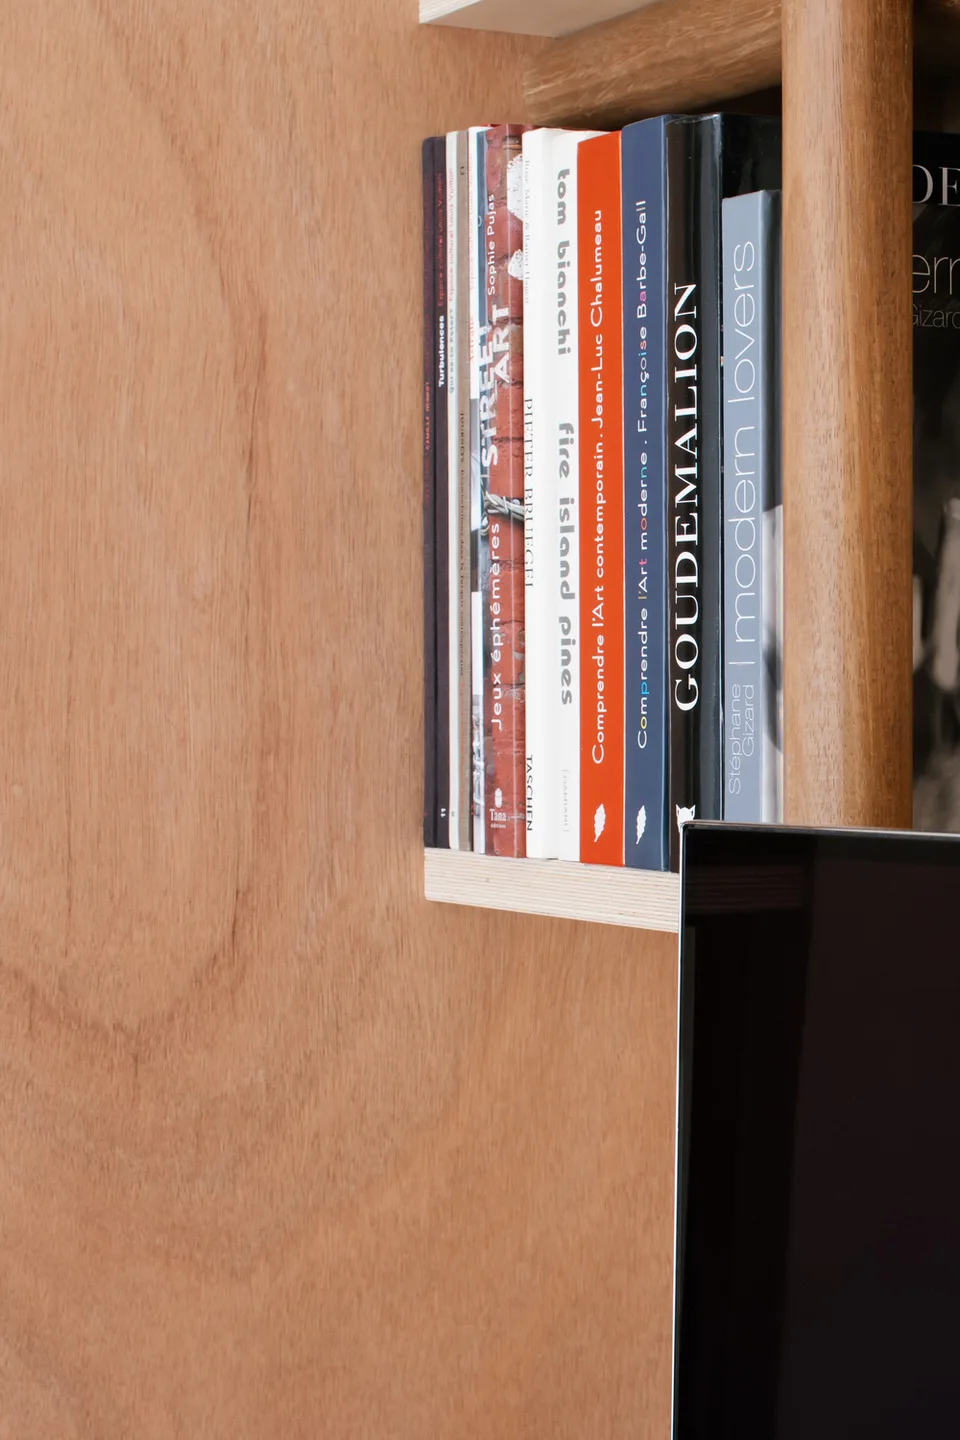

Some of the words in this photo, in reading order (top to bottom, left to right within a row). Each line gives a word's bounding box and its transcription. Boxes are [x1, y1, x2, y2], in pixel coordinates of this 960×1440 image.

[486, 193, 496, 229] Pujas
[556, 167, 571, 226] tom
[486, 241, 497, 297] Sophie
[556, 239, 571, 357] bianchi
[590, 208, 604, 329] Chalumeau
[635, 199, 648, 320] Barbe-Gall
[438, 314, 446, 388] Turbulences
[491, 303, 510, 385] ART
[727, 240, 757, 404] lovers
[479, 323, 498, 468] STREET
[590, 332, 604, 430] Jean-Luc
[637, 325, 650, 434] Françoise
[558, 422, 575, 480] fire
[637, 449, 648, 551] moderne
[673, 281, 700, 713] GOUDEMALION
[558, 496, 576, 601] island
[594, 439, 607, 580] contemporain
[727, 424, 757, 645] modern
[489, 522, 502, 663] éphémères
[591, 584, 605, 628] l'Art
[637, 557, 648, 601] l'Art
[489, 671, 502, 731] Jeux
[557, 615, 577, 707] pines
[591, 633, 607, 765] Comprendre
[637, 606, 650, 750] Comprendre
[728, 682, 743, 796] Stéphane
[741, 683, 756, 758] Gizard
[525, 754, 534, 832] TASCHEN
